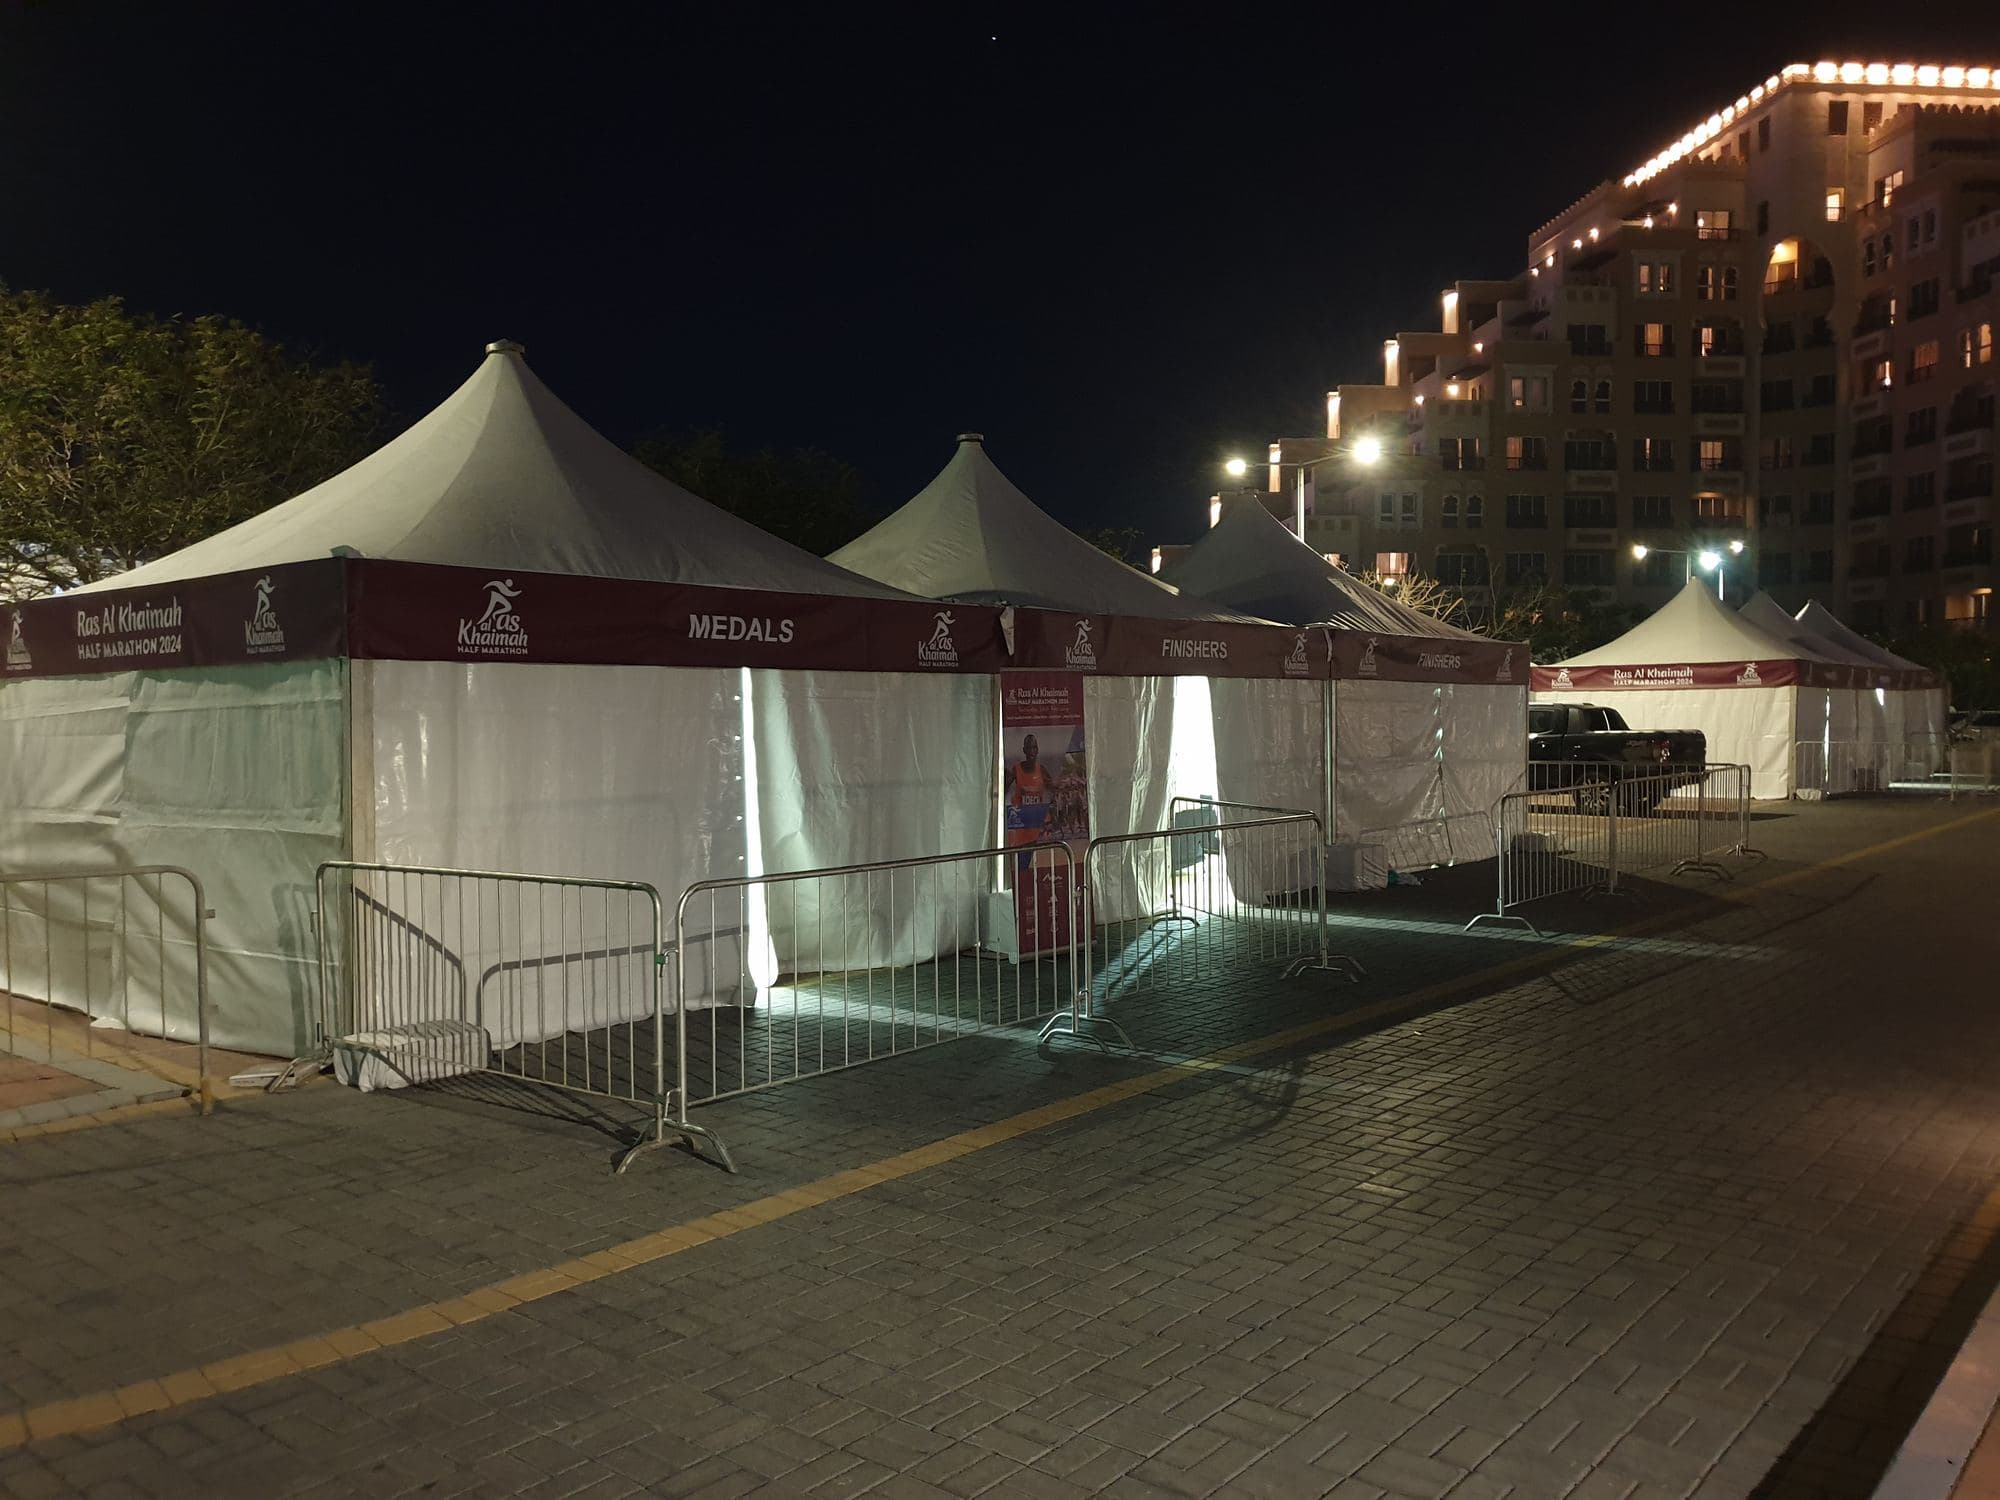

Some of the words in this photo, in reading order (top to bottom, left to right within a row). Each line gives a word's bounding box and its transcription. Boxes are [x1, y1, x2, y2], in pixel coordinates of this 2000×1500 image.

[77, 610, 100, 637] Ras
[102, 604, 115, 634] Al
[118, 596, 182, 632] Khaimah
[480, 618, 491, 631] al
[457, 618, 528, 647] Khaimah
[688, 614, 795, 643] MEDALS
[78, 643, 101, 660] HALF
[103, 637, 158, 658] MARATHON
[159, 634, 182, 654] 2024
[457, 645, 480, 653] HALF
[482, 646, 529, 655] MARATHON
[918, 640, 959, 661] Khaimah
[1162, 639, 1228, 659] FINISHERS
[1417, 652, 1461, 669] FINISHERS
[1614, 669, 1632, 679] Ras
[1634, 668, 1644, 678] Al
[1647, 666, 1694, 678] Khaimah
